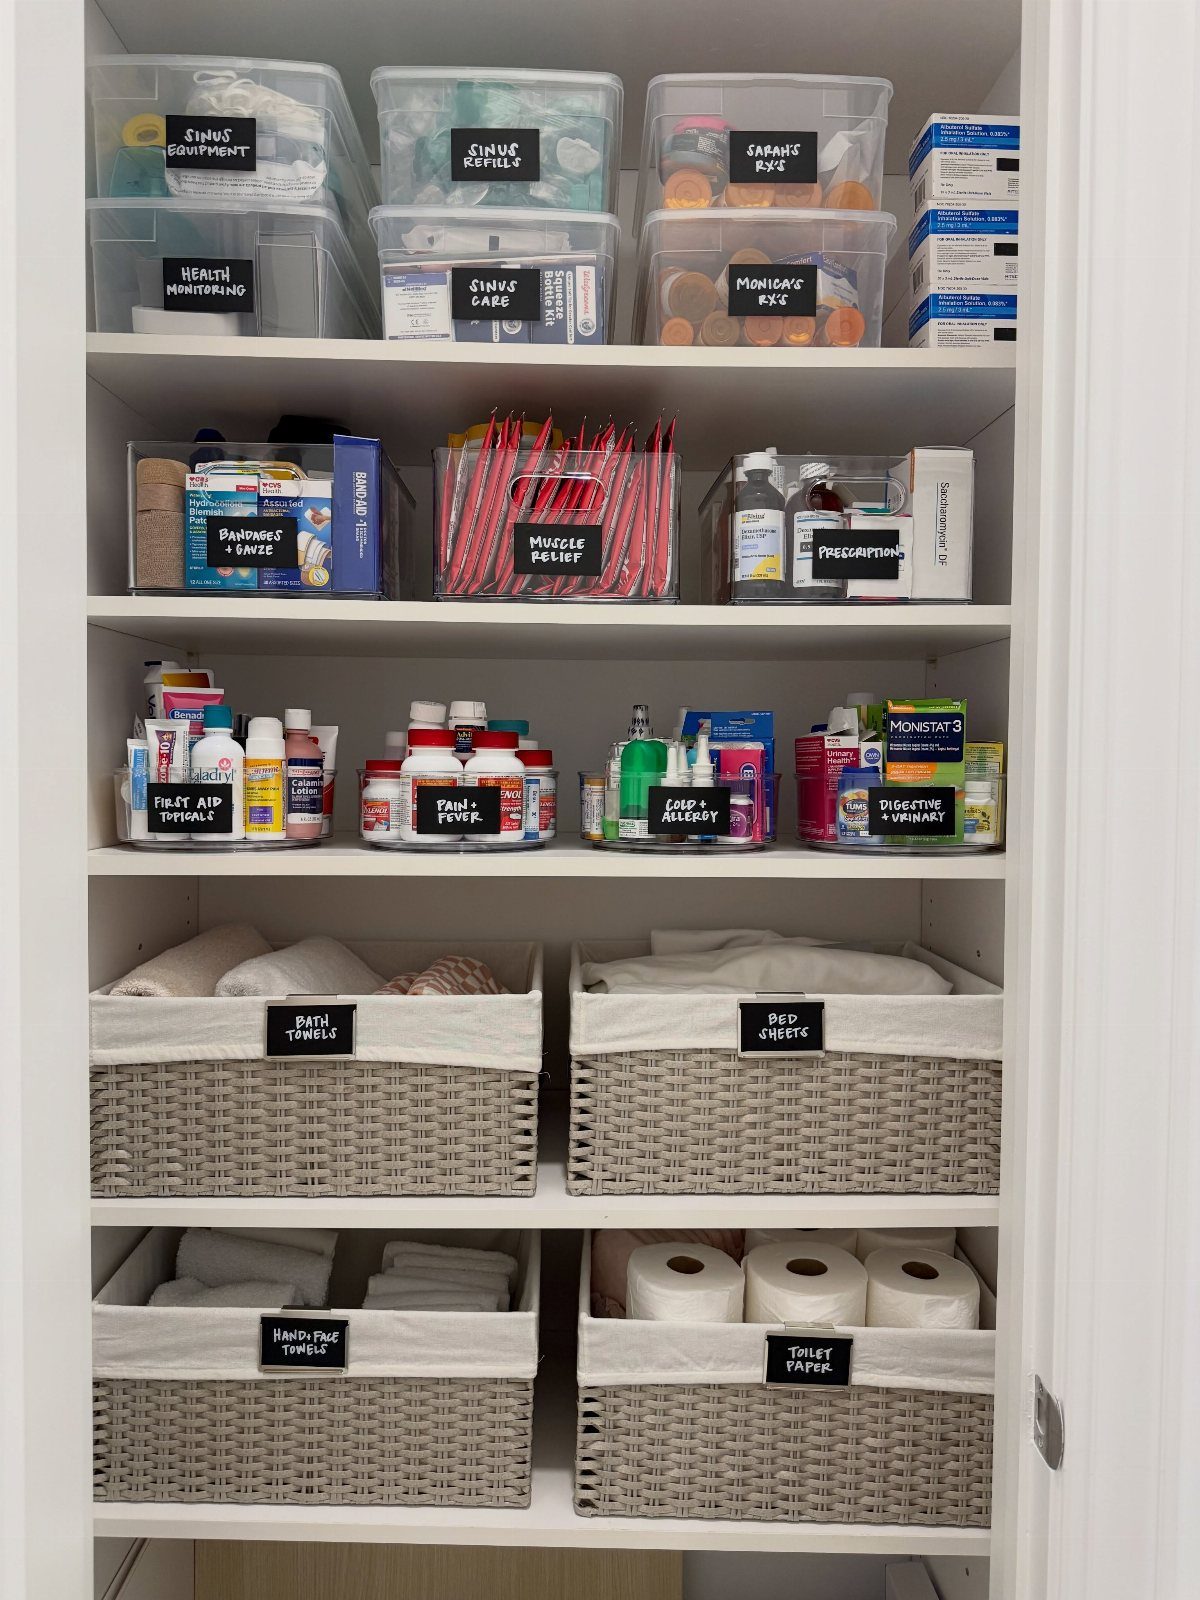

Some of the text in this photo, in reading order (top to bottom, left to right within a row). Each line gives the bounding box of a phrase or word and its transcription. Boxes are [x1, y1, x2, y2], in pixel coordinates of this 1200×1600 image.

[184, 128, 232, 142] SINUS
[167, 144, 250, 158] EQUIPMENT
[468, 142, 519, 156] SINUS
[746, 144, 800, 157] SARAH'S
[463, 156, 522, 168] REFILLS
[755, 159, 786, 172] RX'S
[181, 266, 230, 282] HEALTH
[166, 284, 246, 296] MONITORING
[469, 278, 518, 292] SINUS
[736, 277, 804, 291] MONICA'S
[544, 270, 555, 327] Bottle Kit
[553, 270, 564, 319] Squeeze
[758, 293, 788, 306] RX'S
[471, 295, 510, 308] CARE
[356, 472, 367, 516] BAND-AID
[219, 528, 283, 541] BANDAGES
[530, 536, 585, 549] MUSCLE
[225, 544, 273, 556] + GAUZE
[819, 544, 899, 559] PRESCRIPTION
[532, 552, 582, 563] RELIEF
[890, 720, 962, 732] MONISTAT 3
[154, 796, 222, 809] FIRST AID
[437, 798, 468, 812] PAIN
[665, 798, 706, 811] COLD +
[879, 799, 942, 811] DIGESTIVE
[160, 811, 214, 822] TOPICALS
[438, 812, 483, 824] FEVER
[662, 810, 718, 823] ALLERGY
[892, 812, 946, 822] URINARY
[296, 1014, 329, 1029] BATH
[768, 1012, 798, 1026] BED
[285, 1027, 337, 1041] TOWELS
[758, 1026, 810, 1041] SHEETS
[313, 1331, 339, 1343] FACE
[282, 1343, 328, 1355] TOWELS
[788, 1346, 833, 1360] TOILET
[786, 1361, 833, 1373] PAPER
